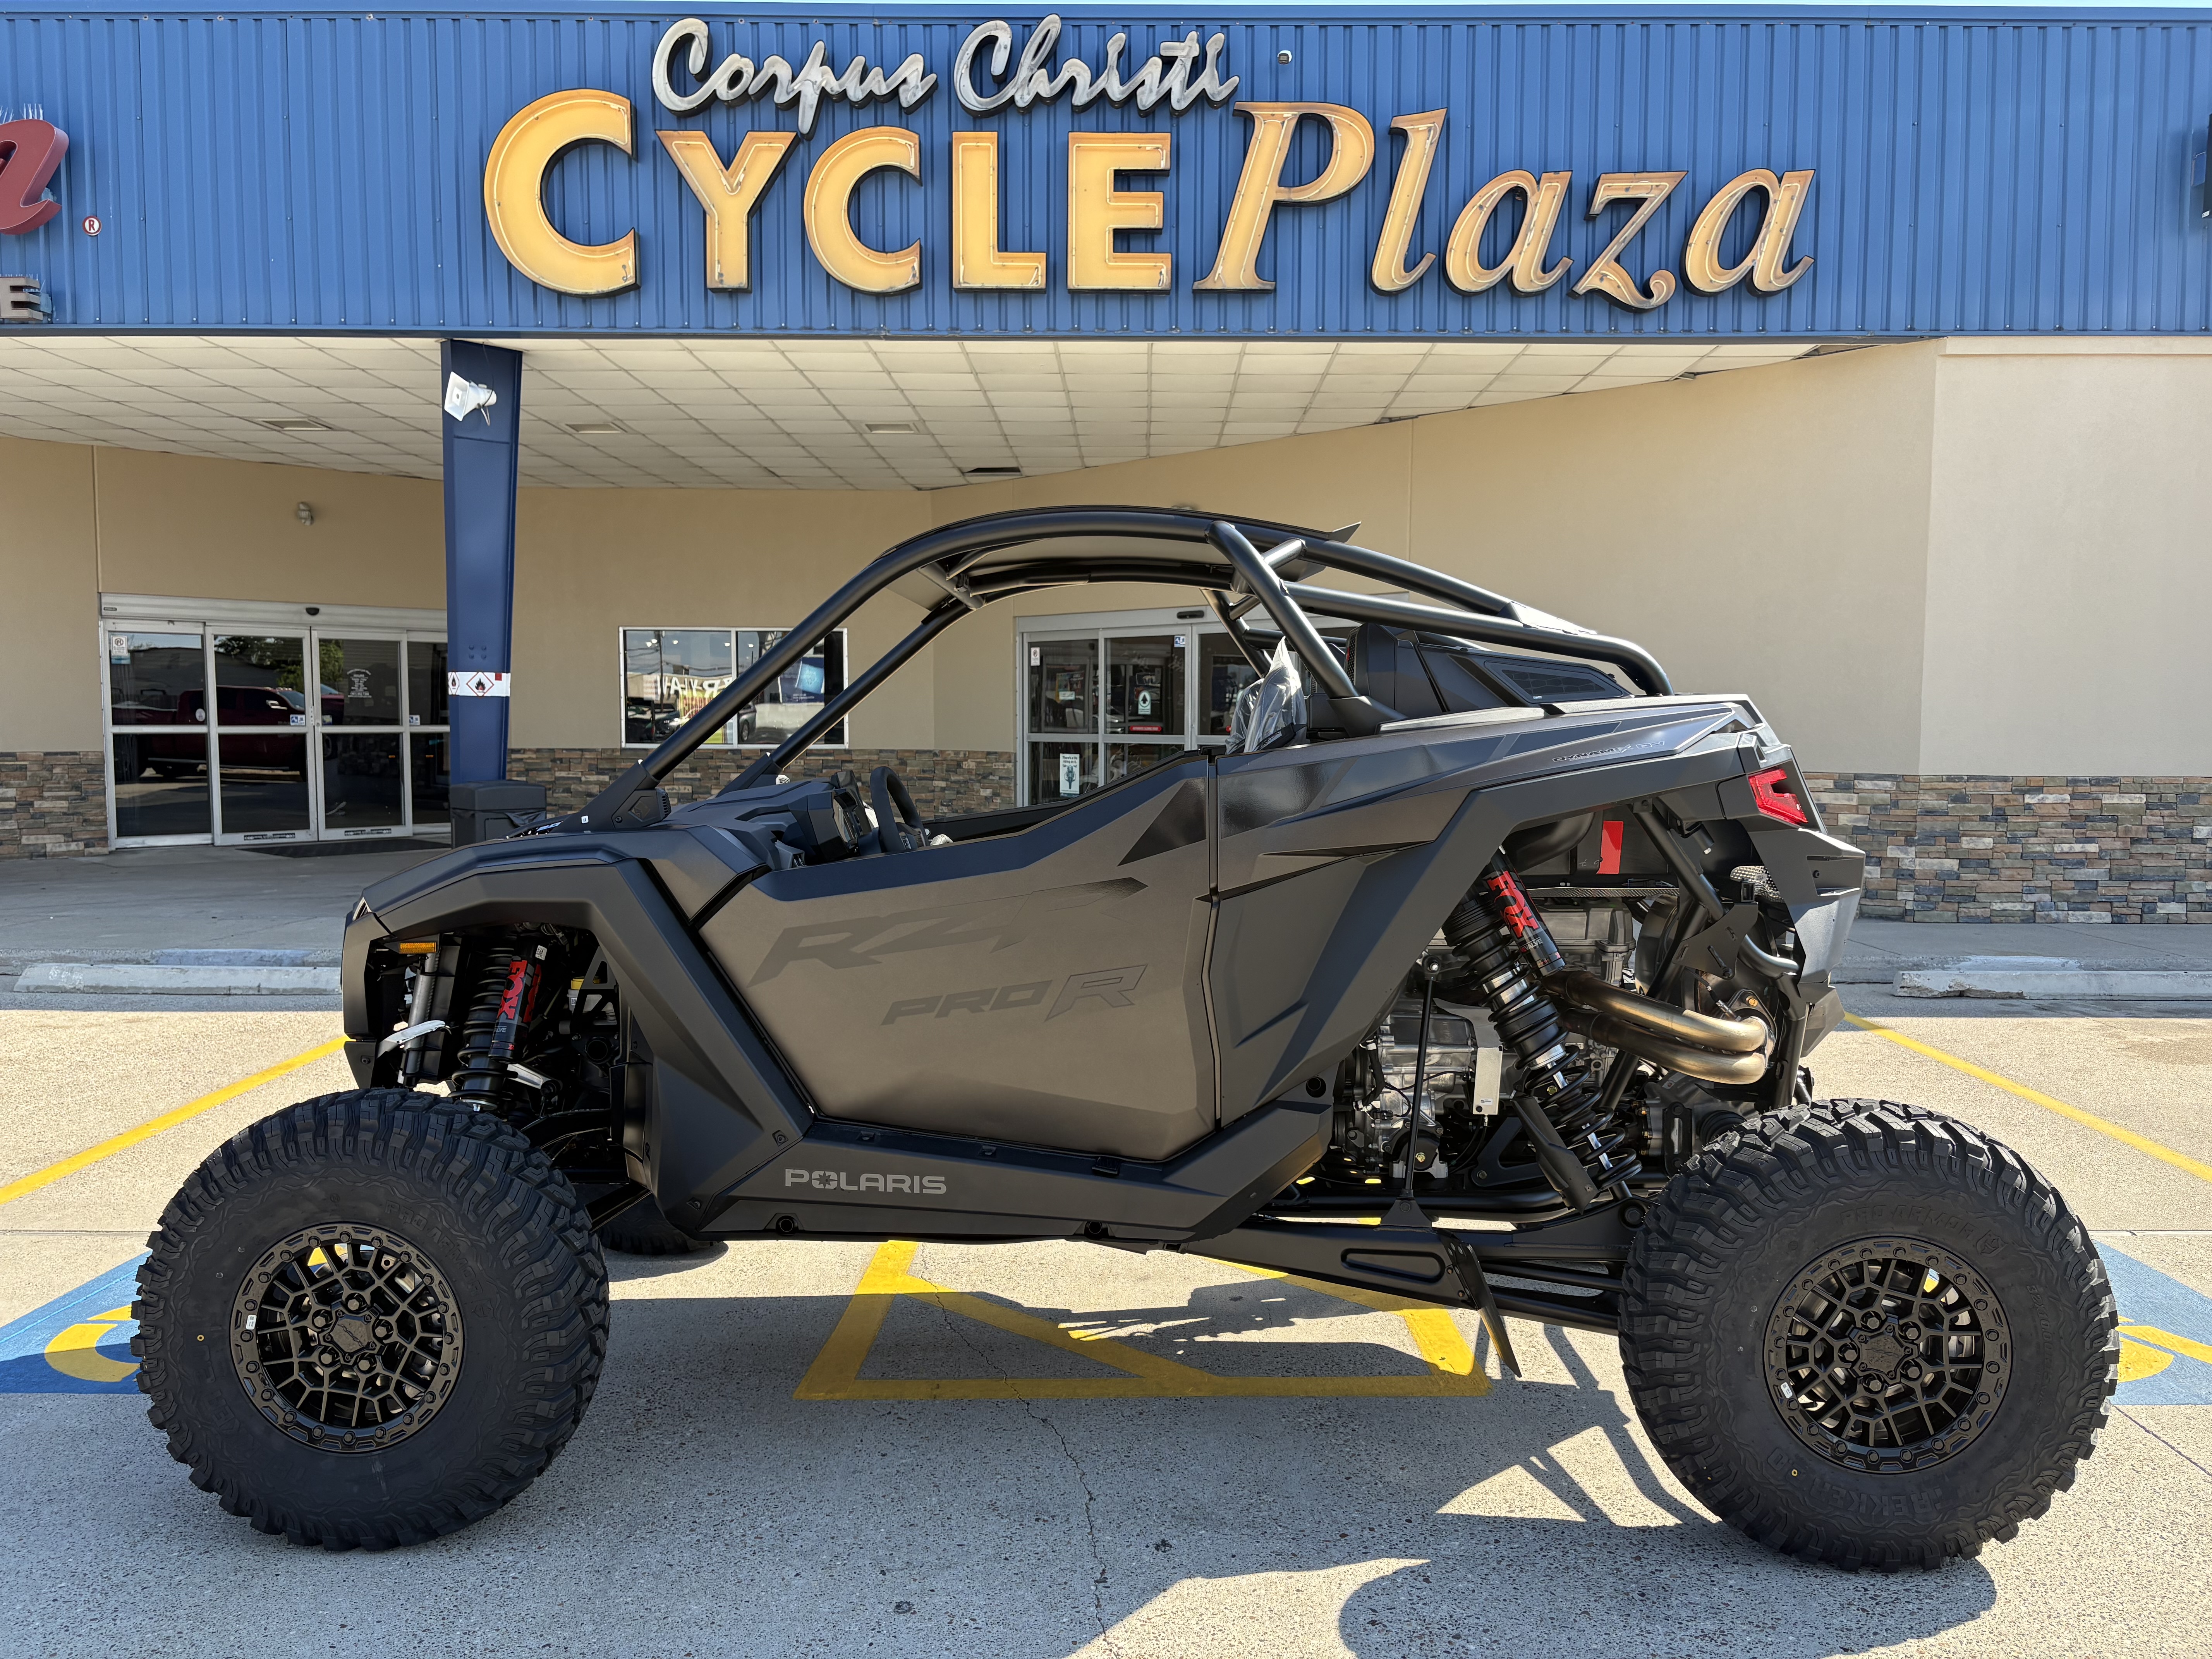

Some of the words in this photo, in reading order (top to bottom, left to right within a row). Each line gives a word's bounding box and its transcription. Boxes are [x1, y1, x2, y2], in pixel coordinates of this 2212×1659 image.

[652, 17, 938, 139] Corpus
[954, 13, 1240, 117] Christi
[484, 88, 1172, 297] CYCLE
[1192, 100, 1816, 313] Plaza
[1552, 744, 1633, 762] DYNAMIX
[1487, 871, 1539, 938] FOX
[496, 960, 528, 1019] FOX
[881, 979, 1052, 1025] PRO
[1044, 964, 1148, 1023] R
[785, 1168, 947, 1194] POLARIS
